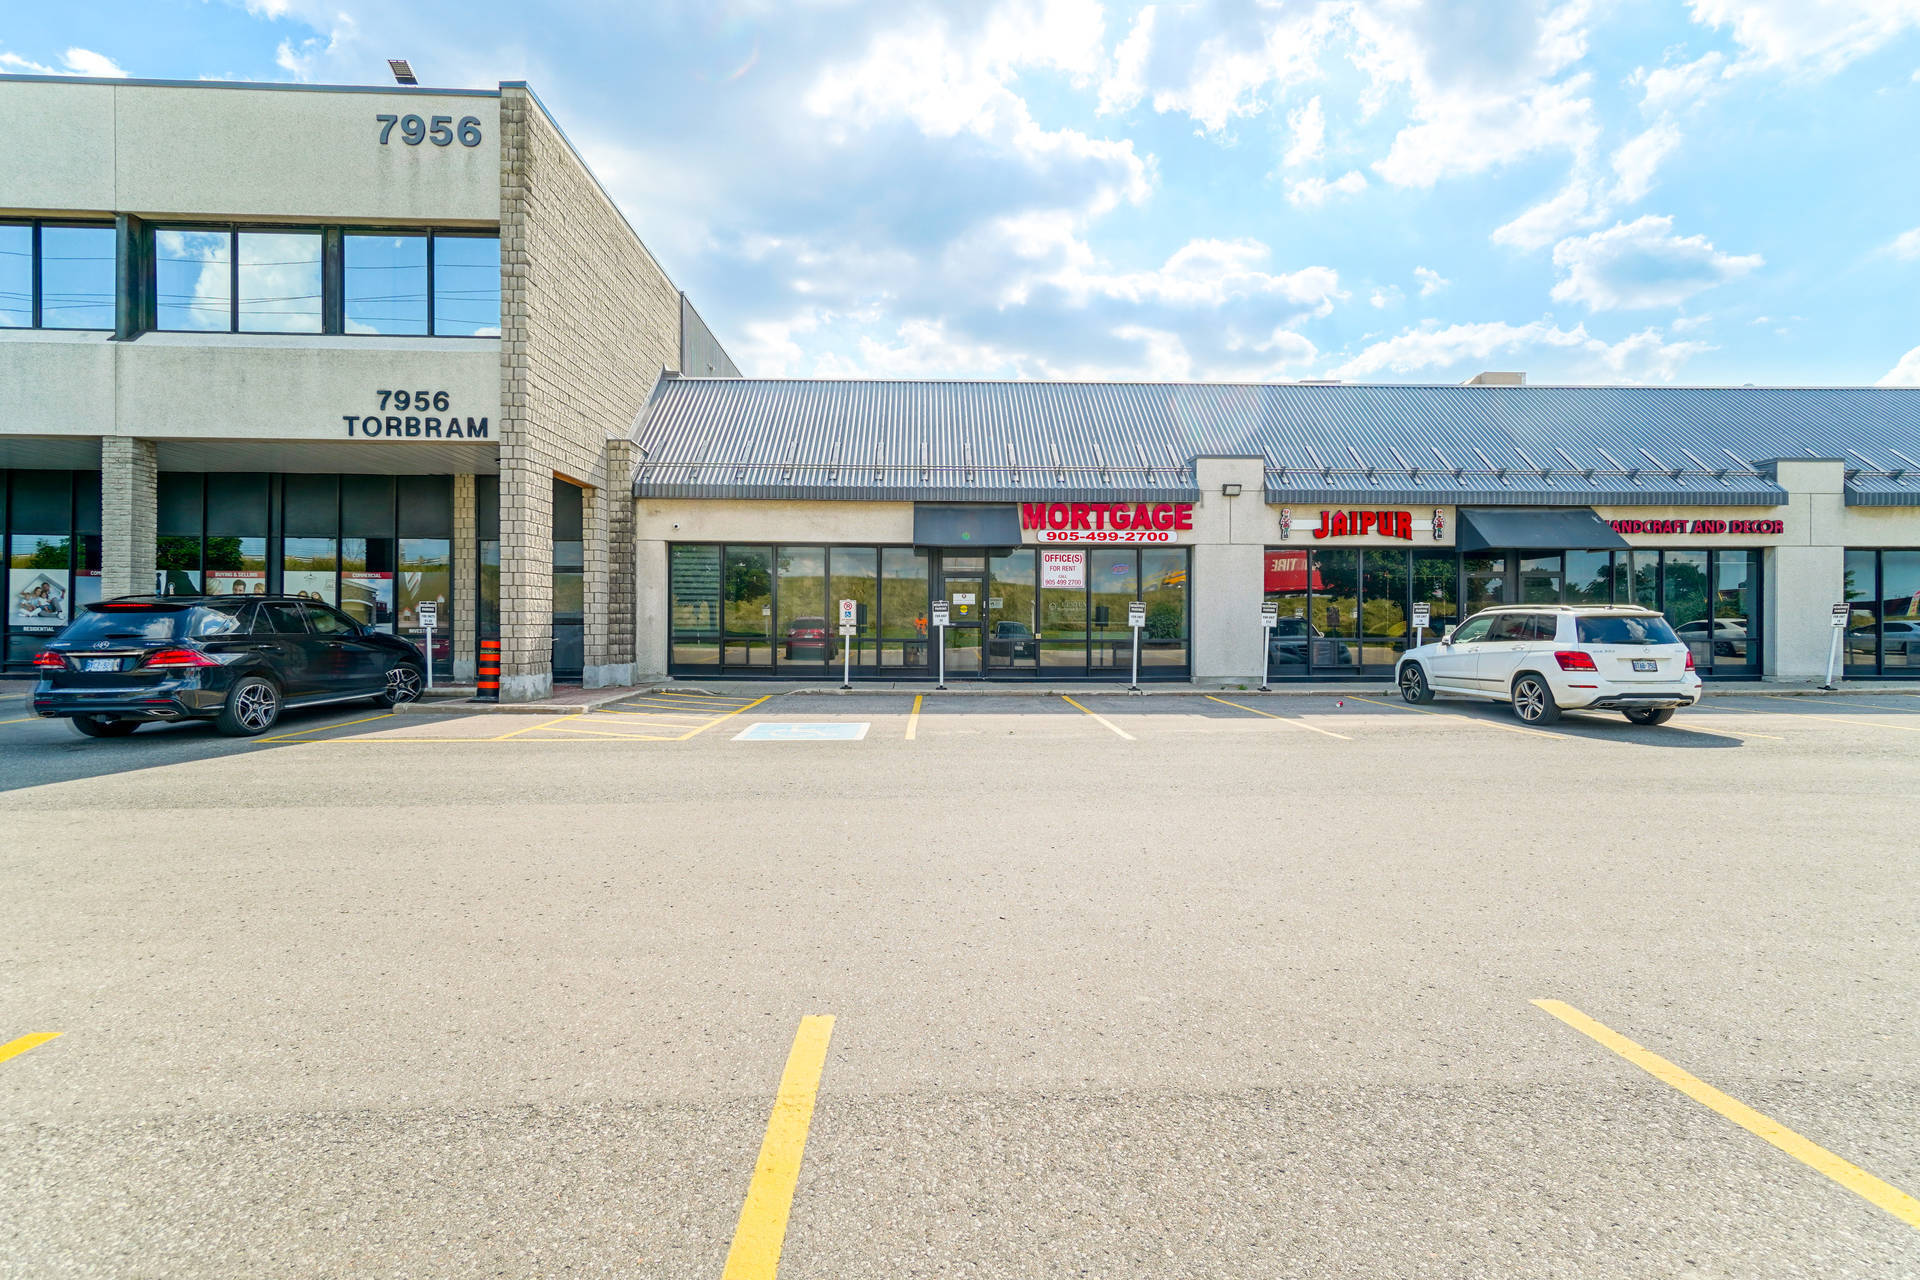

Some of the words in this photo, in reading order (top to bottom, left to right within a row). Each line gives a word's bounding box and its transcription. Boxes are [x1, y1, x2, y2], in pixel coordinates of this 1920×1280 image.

[376, 114, 482, 147] 7956
[376, 390, 450, 412] 7956
[342, 416, 488, 438] TORBRAM
[1022, 503, 1193, 530] MORTGAGE
[1312, 509, 1414, 541] JAIPUR
[1605, 519, 1689, 534] ANDCRAFT
[1692, 519, 1727, 534] AND
[1729, 519, 1784, 534] DECOR
[1046, 531, 1169, 541] 905-499-2700
[1044, 554, 1083, 564] OFFICE(S)
